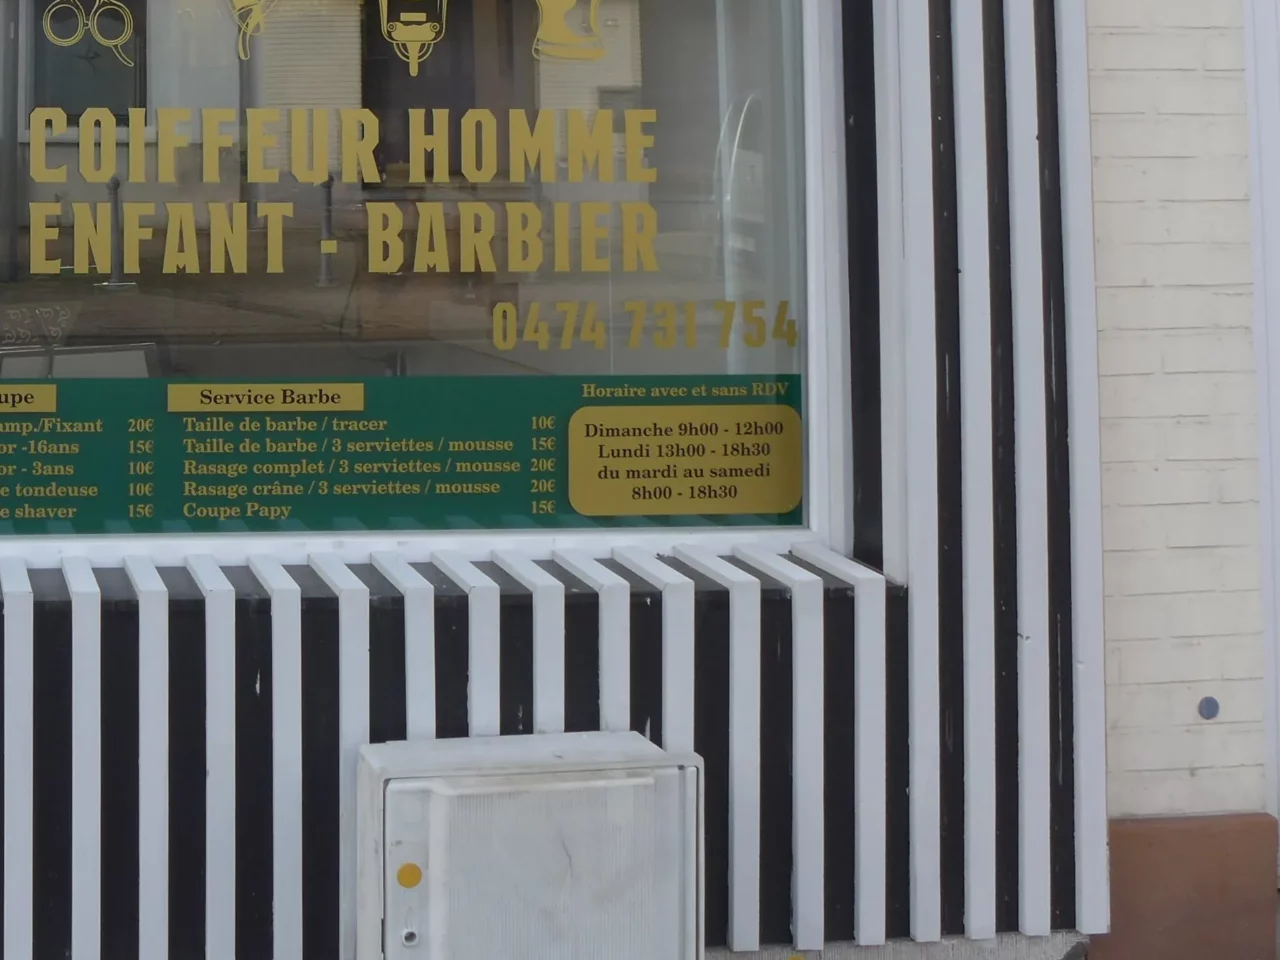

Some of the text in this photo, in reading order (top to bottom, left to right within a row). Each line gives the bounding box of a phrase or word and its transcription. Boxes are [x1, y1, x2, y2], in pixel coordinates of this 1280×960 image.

[29, 107, 657, 186] COIFFEUR HOMME
[29, 201, 294, 274] ENFANT
[367, 201, 659, 273] BARBIER
[492, 300, 798, 351] 0474 731 754
[200, 388, 341, 404] Service Barbe
[582, 382, 789, 398] Horaire avec et sans RDV
[128, 418, 154, 432] 20€
[183, 416, 556, 432] Taille de barbe / tracer 10€
[584, 422, 674, 438] Dimanche
[678, 422, 718, 436] 9h00
[735, 422, 784, 435] 12h00
[22, 440, 80, 454] -16ans
[128, 440, 154, 454] 15€
[183, 437, 556, 453] Taille de barbe / 3 serviettes / mousse 15€
[598, 444, 650, 458] Lundi
[656, 443, 706, 457] 13h00
[721, 442, 770, 456] 18h30
[32, 462, 74, 476] 3ans
[128, 462, 154, 476] 10€
[183, 458, 556, 478] Rasage complet / 3 serviettes / mousse 20€
[598, 463, 770, 480] du mardi au samedi
[16, 482, 98, 497] tondeuse
[128, 483, 154, 496] 10€
[183, 480, 556, 499] Rasage crâne / 3 serviettes / mousse 20€
[631, 486, 672, 500] 8h00
[689, 485, 738, 499] 18h30
[14, 504, 77, 518] shaver
[128, 504, 154, 518] 15€
[183, 500, 556, 520] Coupe Papy 15€
